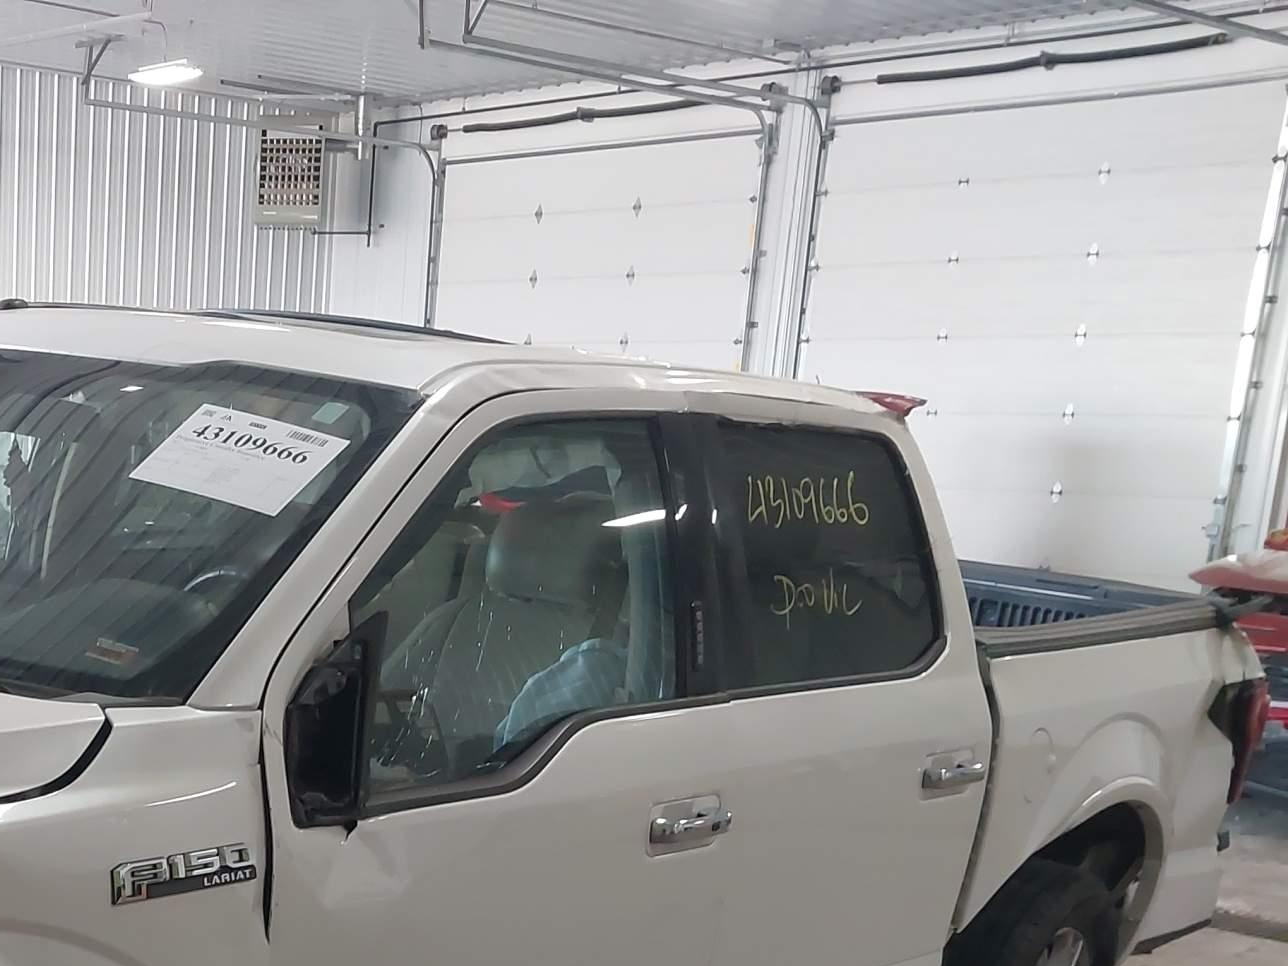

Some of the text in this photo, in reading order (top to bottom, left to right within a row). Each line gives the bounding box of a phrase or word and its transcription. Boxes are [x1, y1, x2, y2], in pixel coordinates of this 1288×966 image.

[192, 423, 313, 465] 43109666
[746, 470, 870, 529] 43109666
[203, 868, 253, 887] LARIAT
